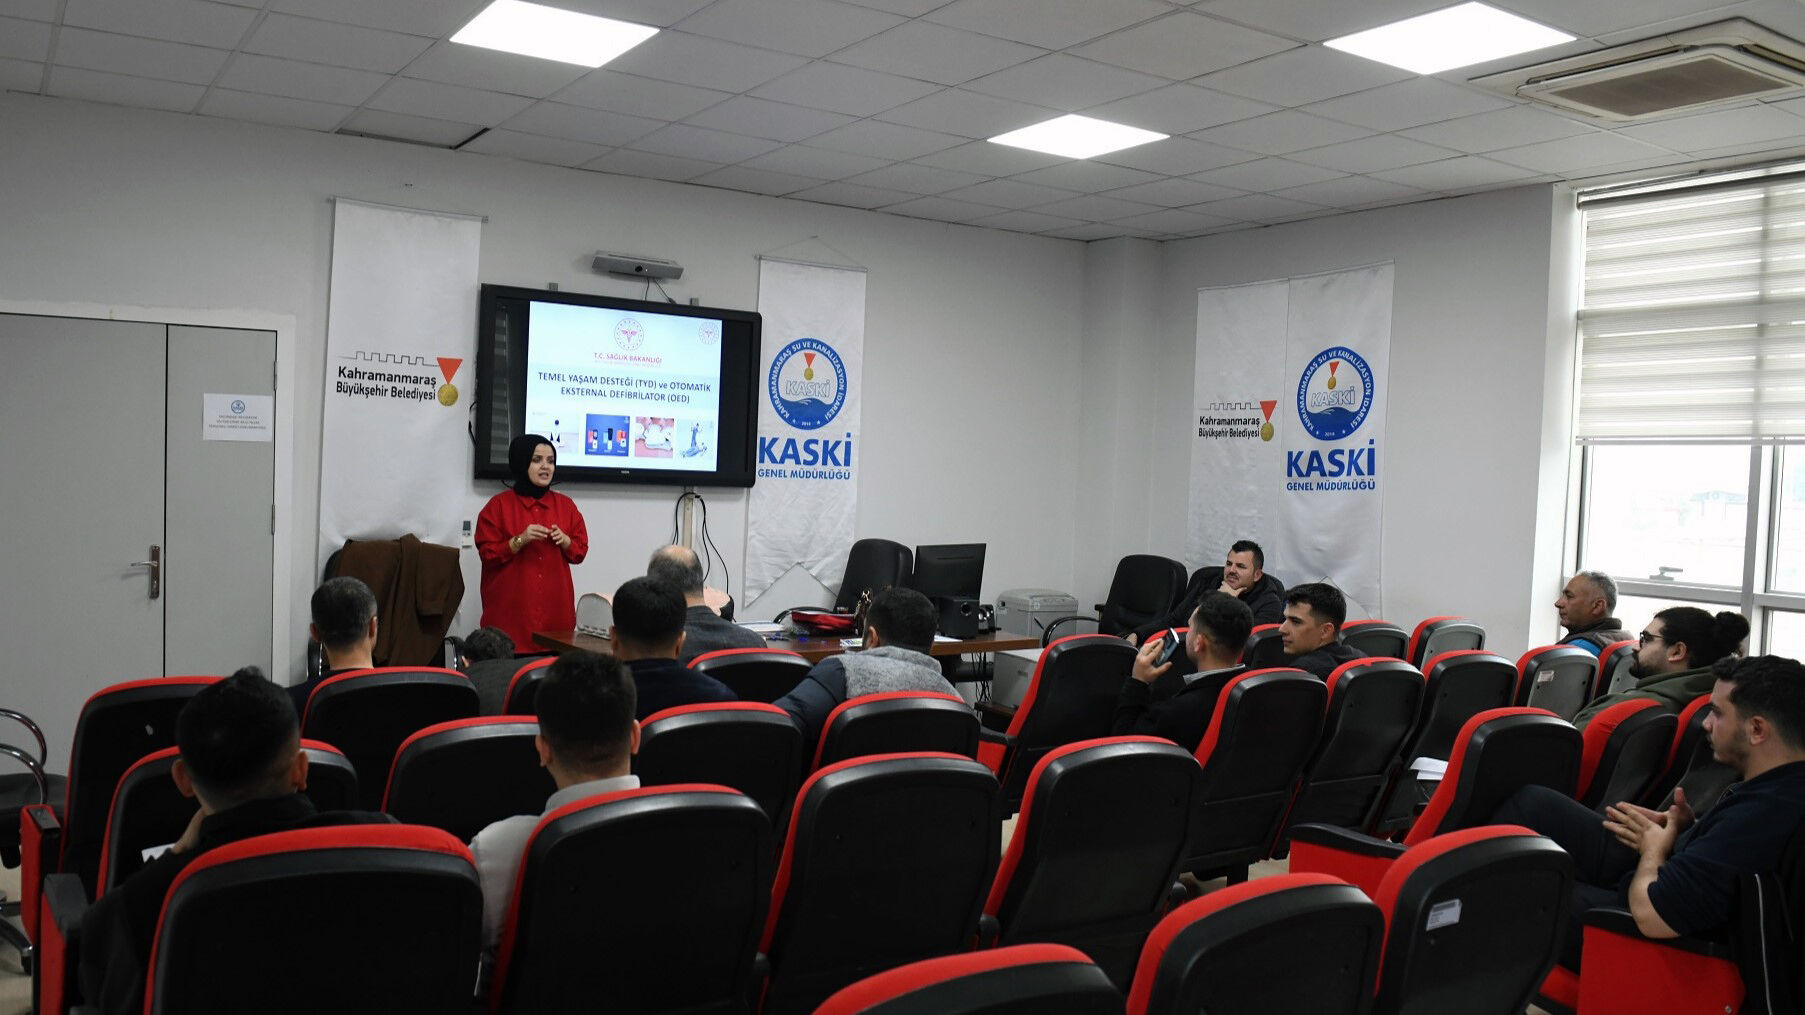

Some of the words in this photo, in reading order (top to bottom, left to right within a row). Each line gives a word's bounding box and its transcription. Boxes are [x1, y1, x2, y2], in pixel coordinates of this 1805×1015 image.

[1318, 354, 1327, 364] SU
[1328, 350, 1337, 358] VE
[338, 366, 437, 389] Kahramanmaraş
[538, 371, 566, 382] TEMEL
[568, 374, 598, 385] YAŞAM
[600, 376, 633, 387] DESTEĞİ
[635, 378, 657, 390] (TYD)
[659, 381, 668, 389] ve
[669, 381, 711, 392] OTOMATİK
[771, 348, 793, 419] KAHRAMANMARAŞ
[792, 343, 801, 352] SU
[812, 341, 844, 391] KANALİZASYON
[336, 381, 389, 399] Büyükşehir
[390, 385, 436, 402] Belediyesi
[560, 386, 607, 398] EKSTERNAL
[609, 388, 666, 402] DEFİBRİLATOR
[667, 393, 690, 404] (OED)
[785, 379, 831, 398] KASKİ
[1310, 385, 1356, 407] KASKİ
[1199, 416, 1260, 428] Kahramanmaraş
[1198, 427, 1229, 440] Büyükşehir
[1229, 427, 1260, 440] Belediyesi
[758, 432, 852, 467] KASKİ
[1287, 438, 1376, 478] KASKİ
[757, 468, 788, 478] GENEL
[790, 468, 851, 480] MÜDÜRLÜĞÜ
[1286, 482, 1314, 491] GENEL
[1316, 479, 1376, 491] MÜDÜRLÜĞÜ
